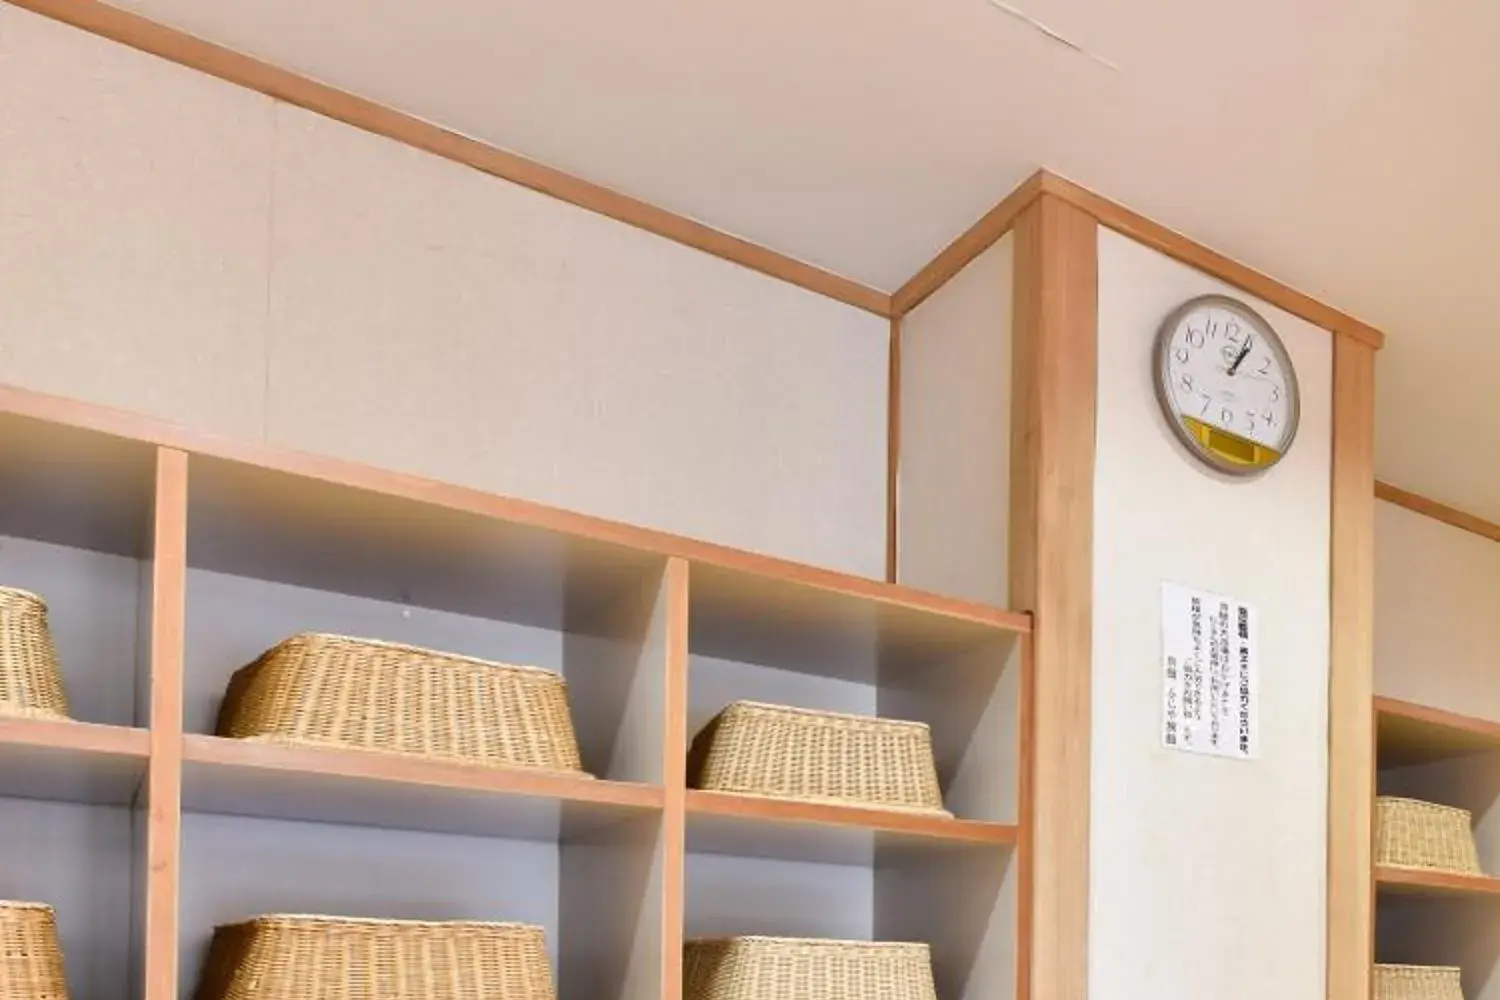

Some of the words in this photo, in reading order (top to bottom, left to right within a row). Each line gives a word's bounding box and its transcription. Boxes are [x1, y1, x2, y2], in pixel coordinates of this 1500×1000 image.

[1186, 324, 1204, 349] 10
[1258, 357, 1271, 374] 2
[1200, 393, 1212, 416] 7
